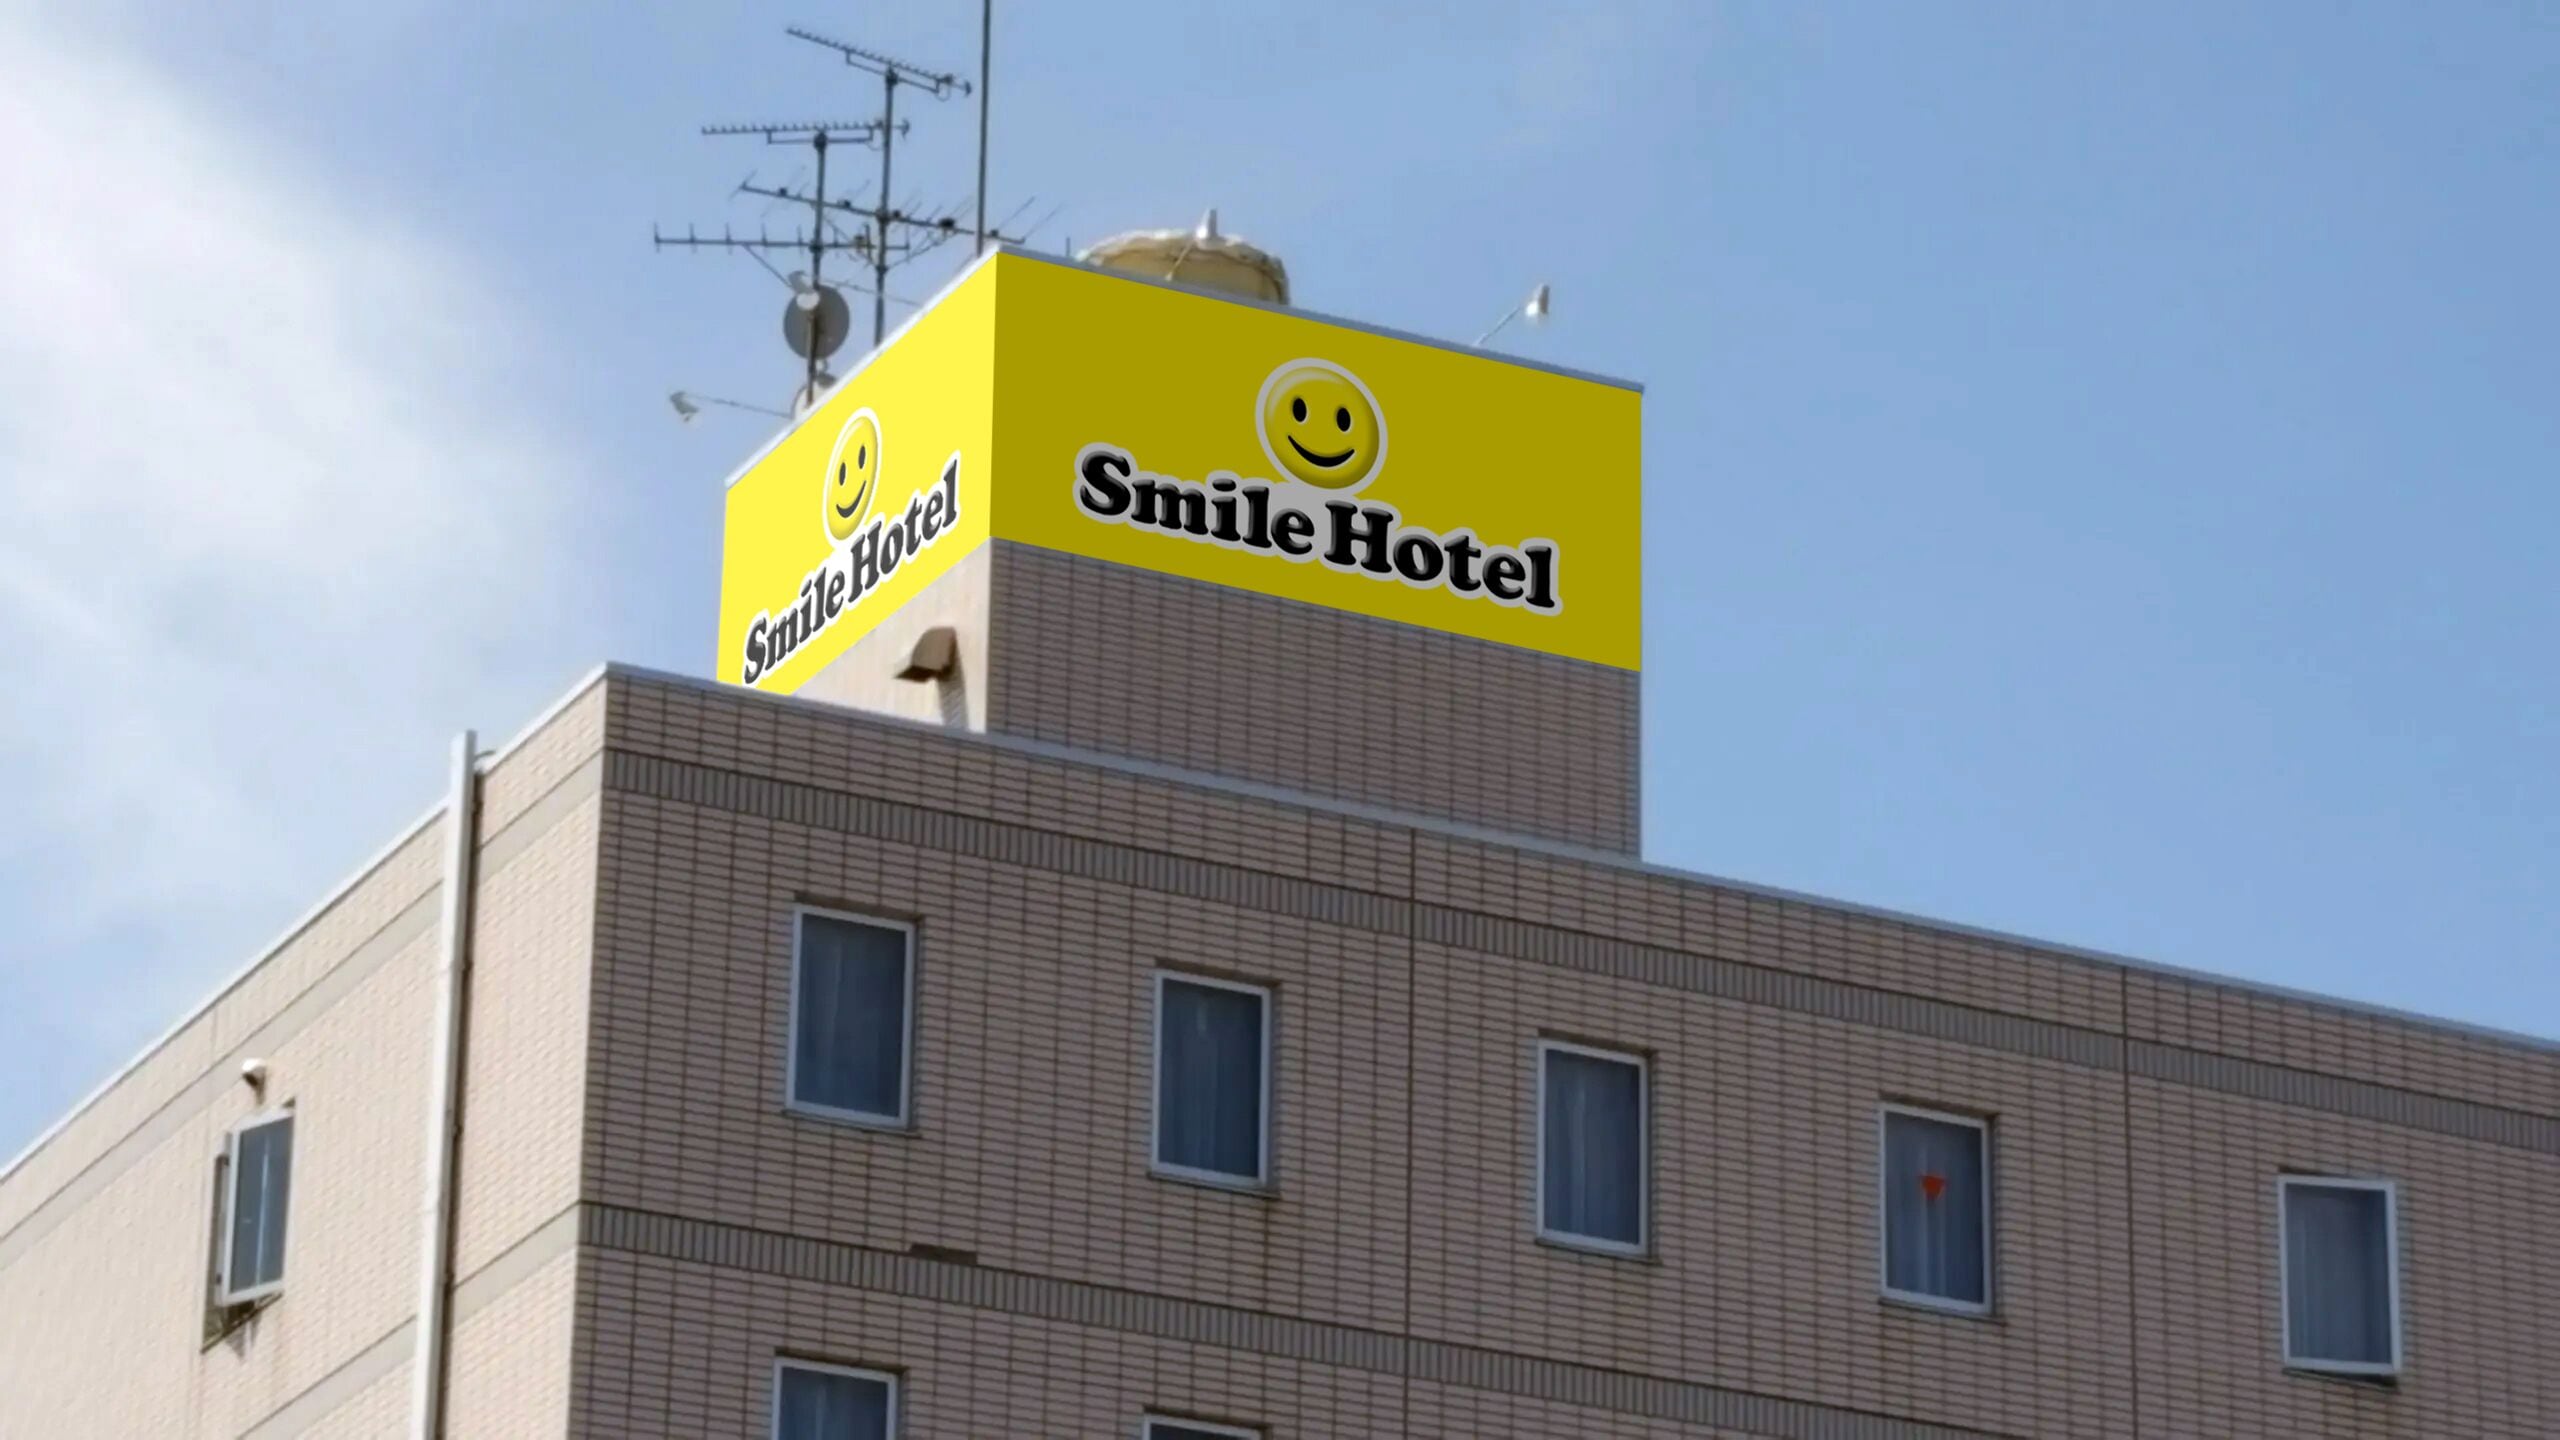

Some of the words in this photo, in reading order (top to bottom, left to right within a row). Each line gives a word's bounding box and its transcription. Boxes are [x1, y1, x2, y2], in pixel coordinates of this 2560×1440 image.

[744, 566, 845, 684] Smile
[848, 458, 957, 603] Hotel
[1080, 450, 1315, 555] Smile
[1324, 500, 1556, 609] Hotel
